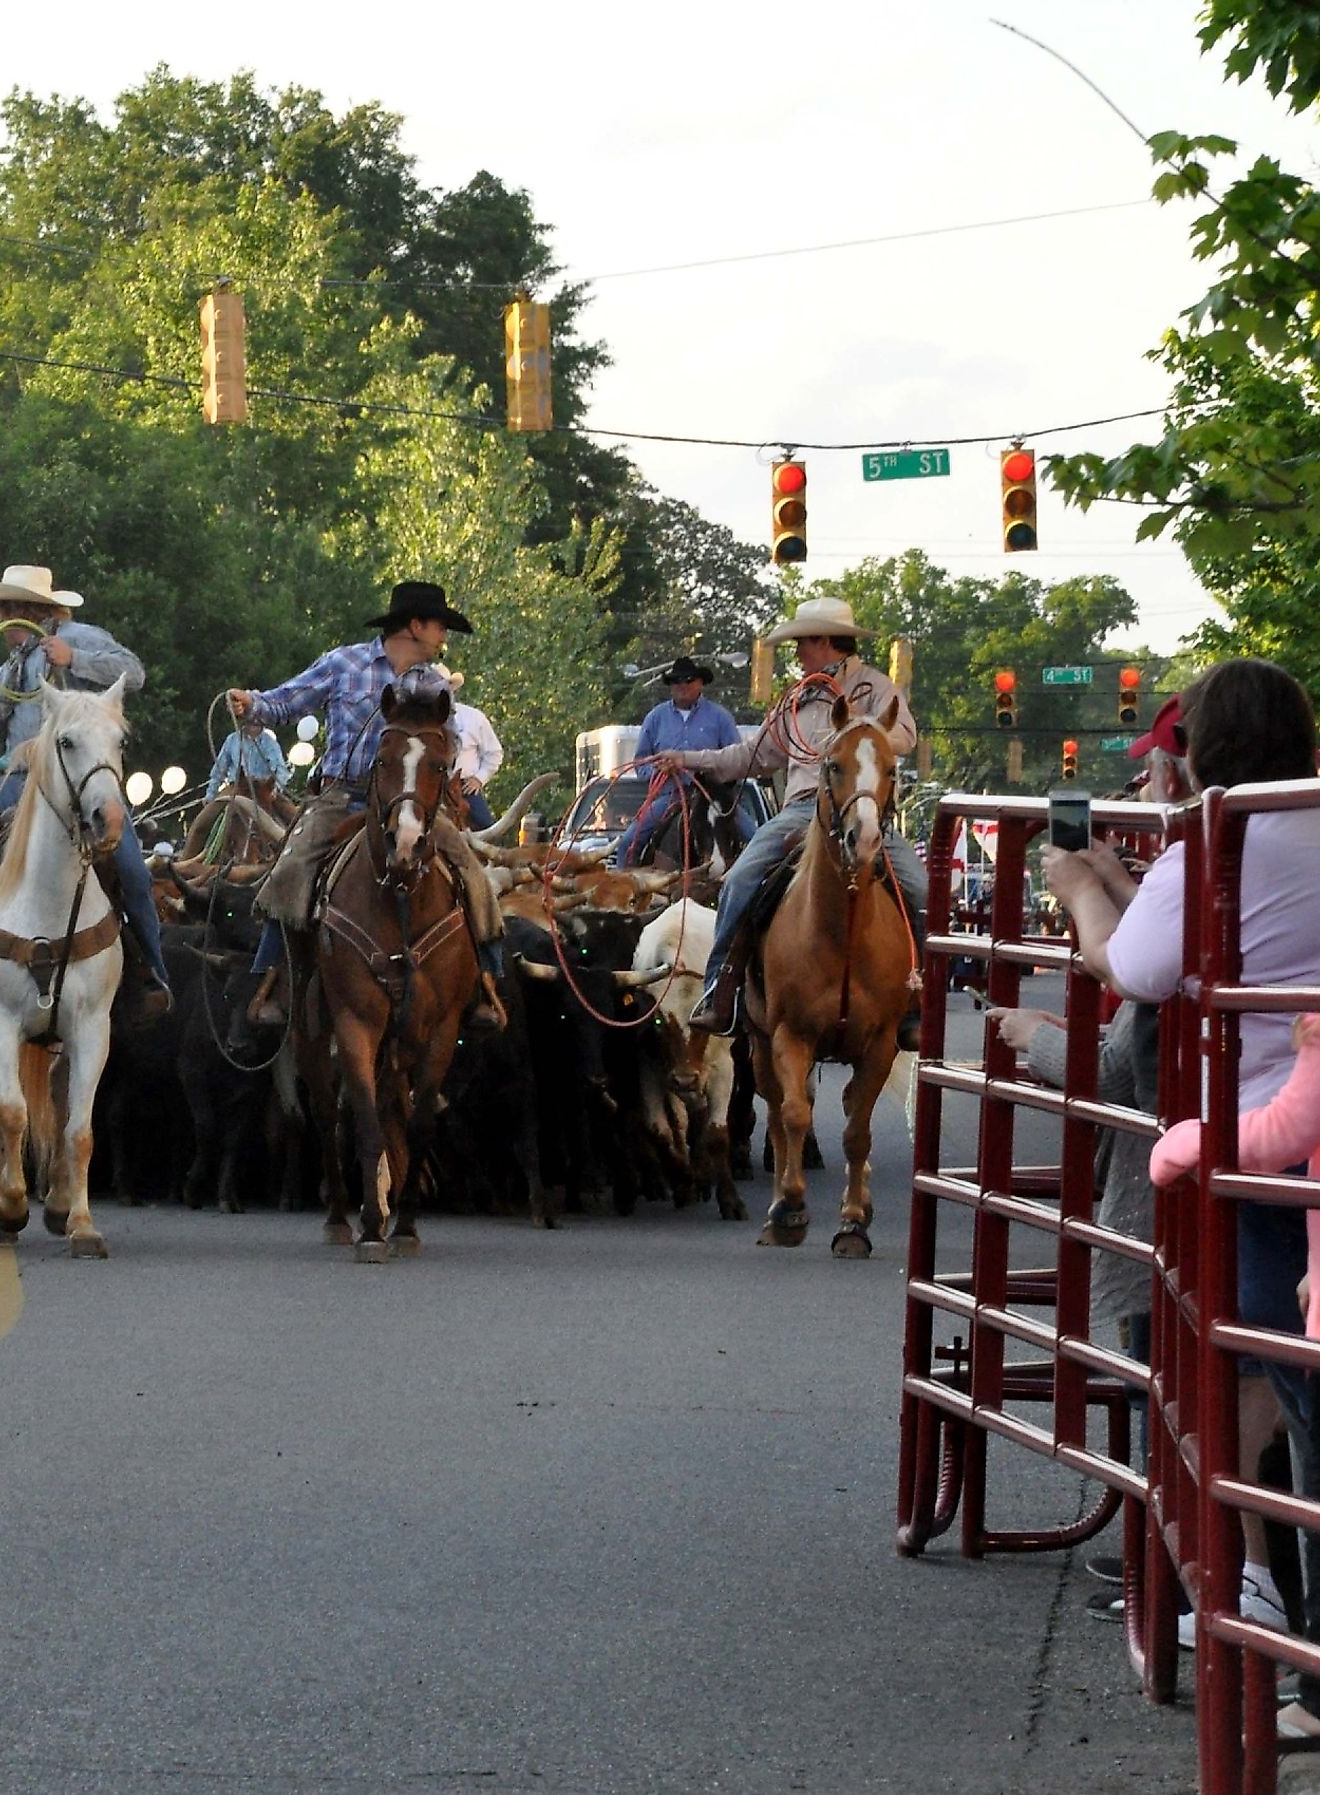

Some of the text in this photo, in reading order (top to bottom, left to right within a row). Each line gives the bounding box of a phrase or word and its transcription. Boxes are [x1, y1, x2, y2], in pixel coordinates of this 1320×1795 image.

[869, 452, 943, 478] 5TH ST
[1074, 670, 1088, 681] ST
